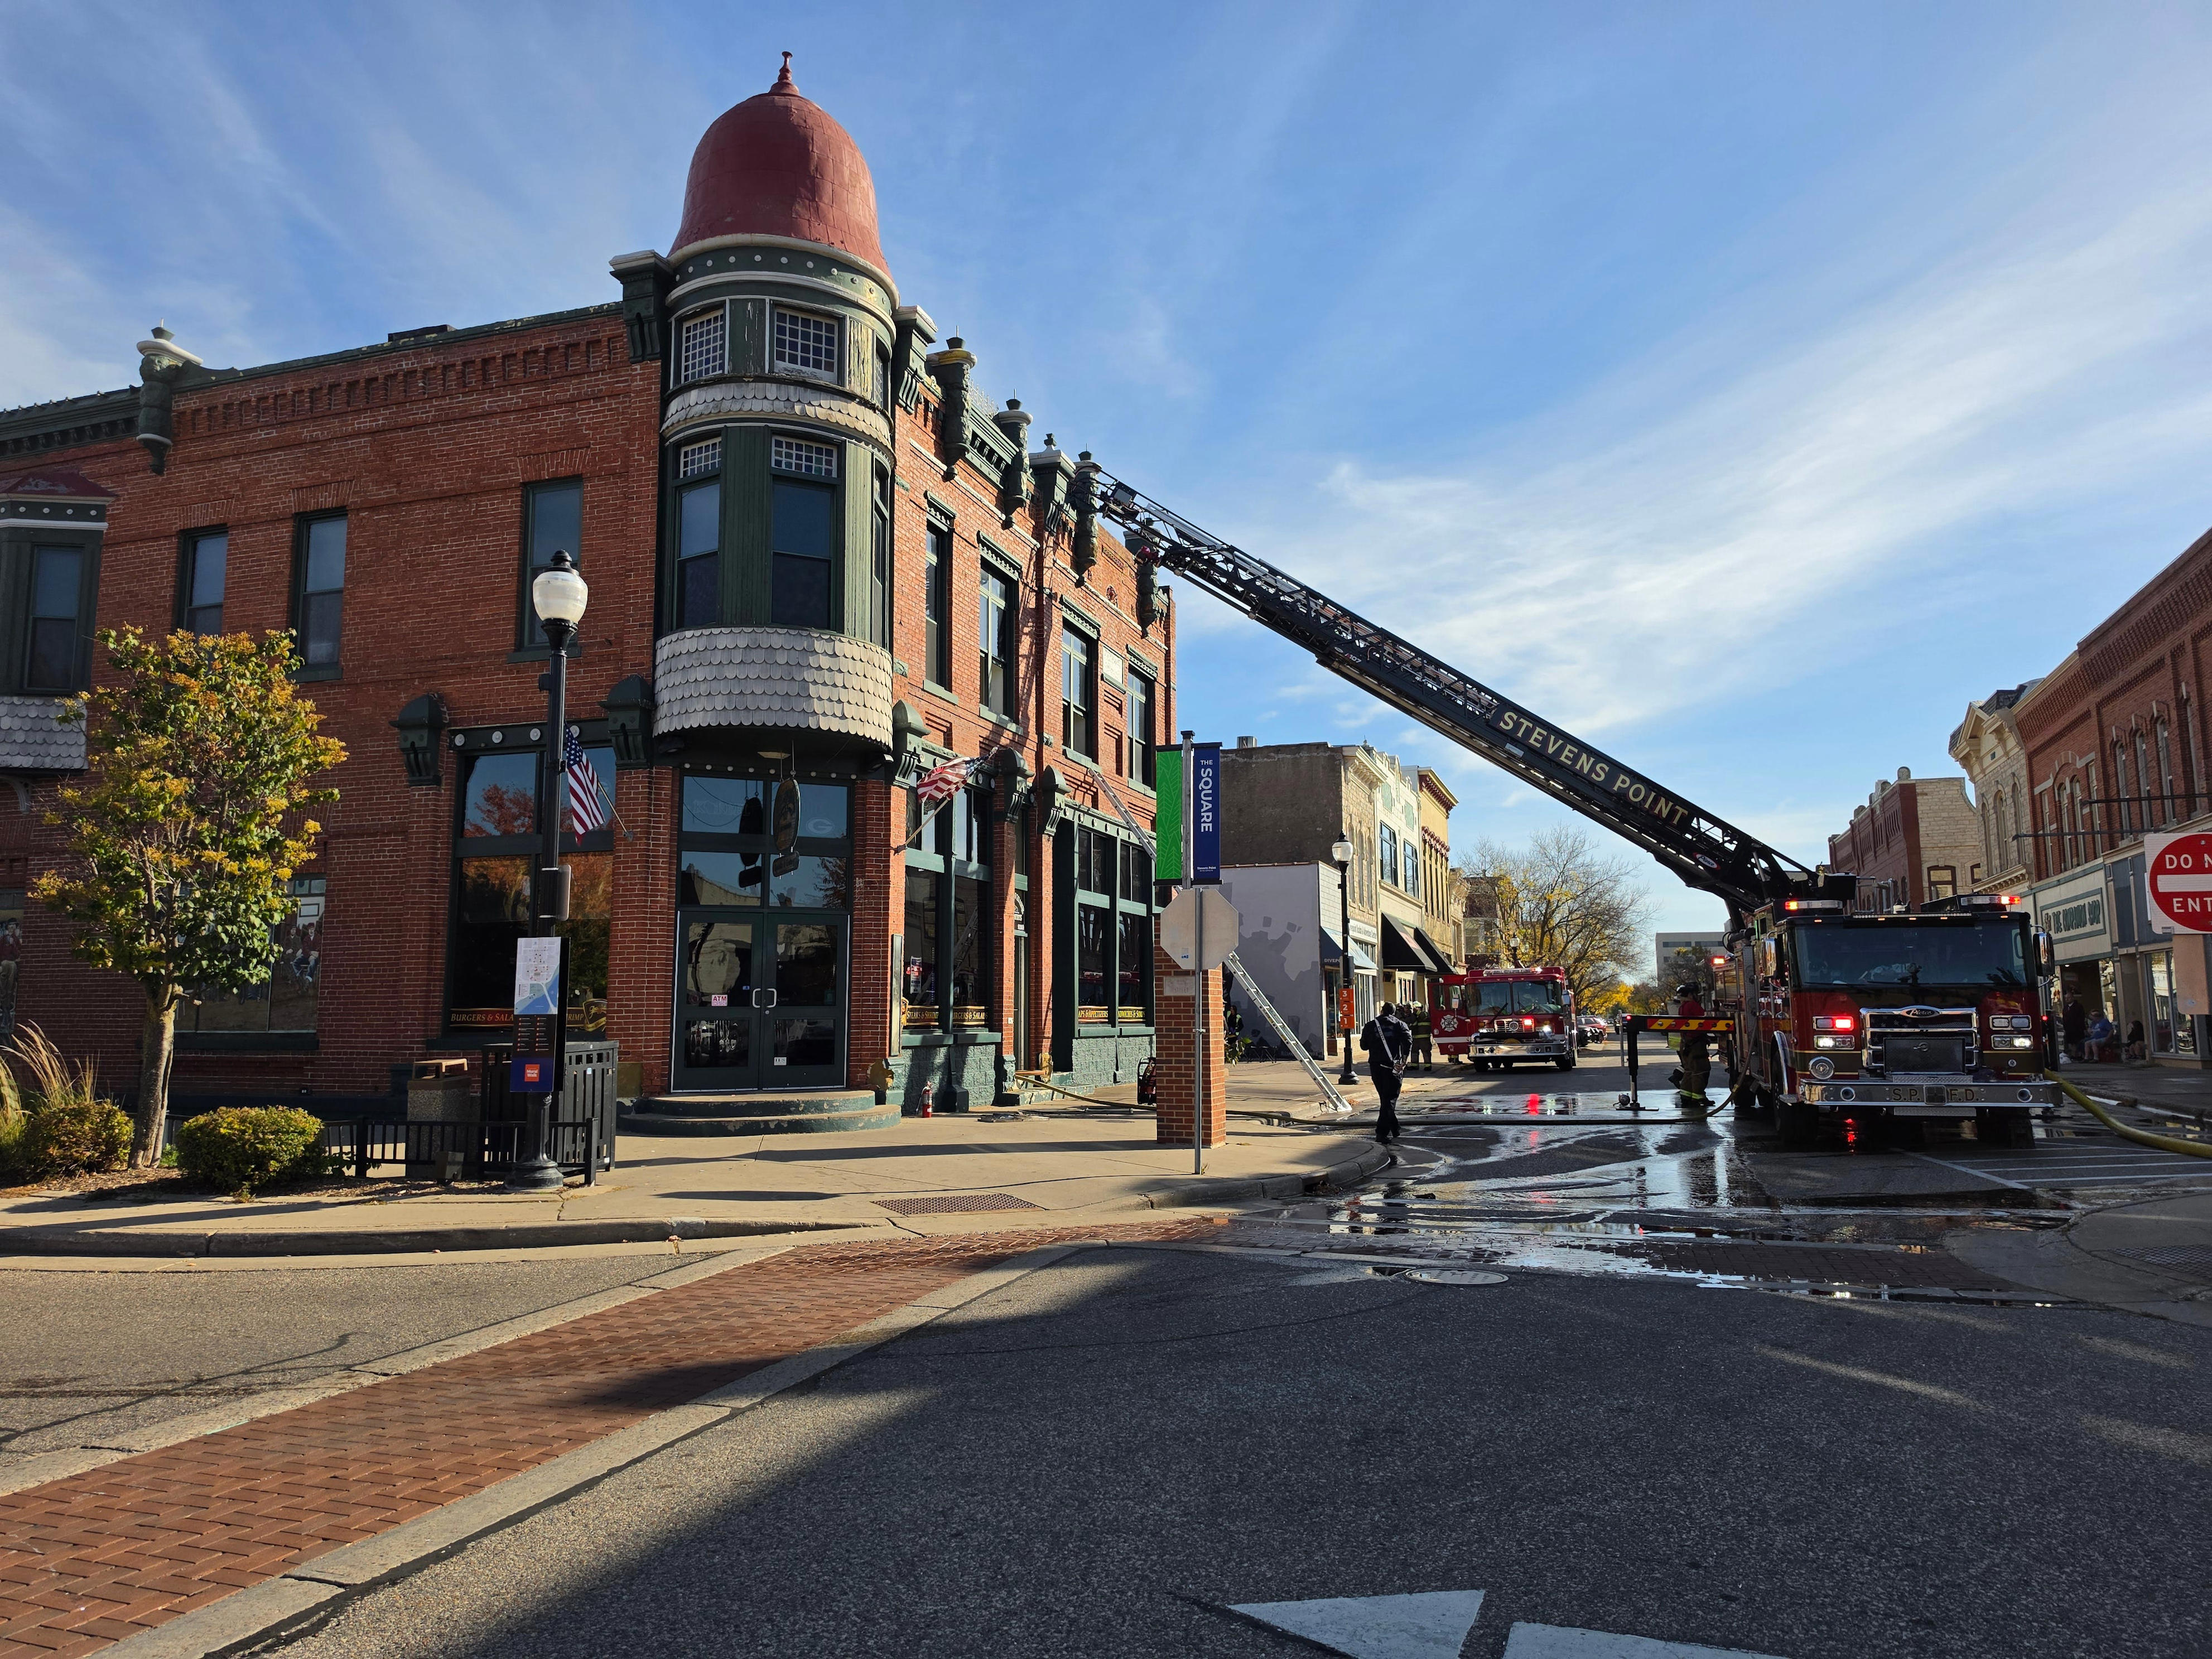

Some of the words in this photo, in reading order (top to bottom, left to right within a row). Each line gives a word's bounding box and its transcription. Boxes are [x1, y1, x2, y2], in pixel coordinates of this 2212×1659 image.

[1499, 711, 1609, 782] STEVENS
[1612, 773, 1688, 826] POINT
[1199, 768, 1213, 832] SQUARE
[2165, 853, 2192, 869] DO
[2051, 910, 2062, 934] THE
[451, 1013, 486, 1022] BURGERS
[907, 1011, 921, 1019] STEAKS
[1892, 1088, 1921, 1101] S.P.
[1949, 1089, 1980, 1102] F.D.
